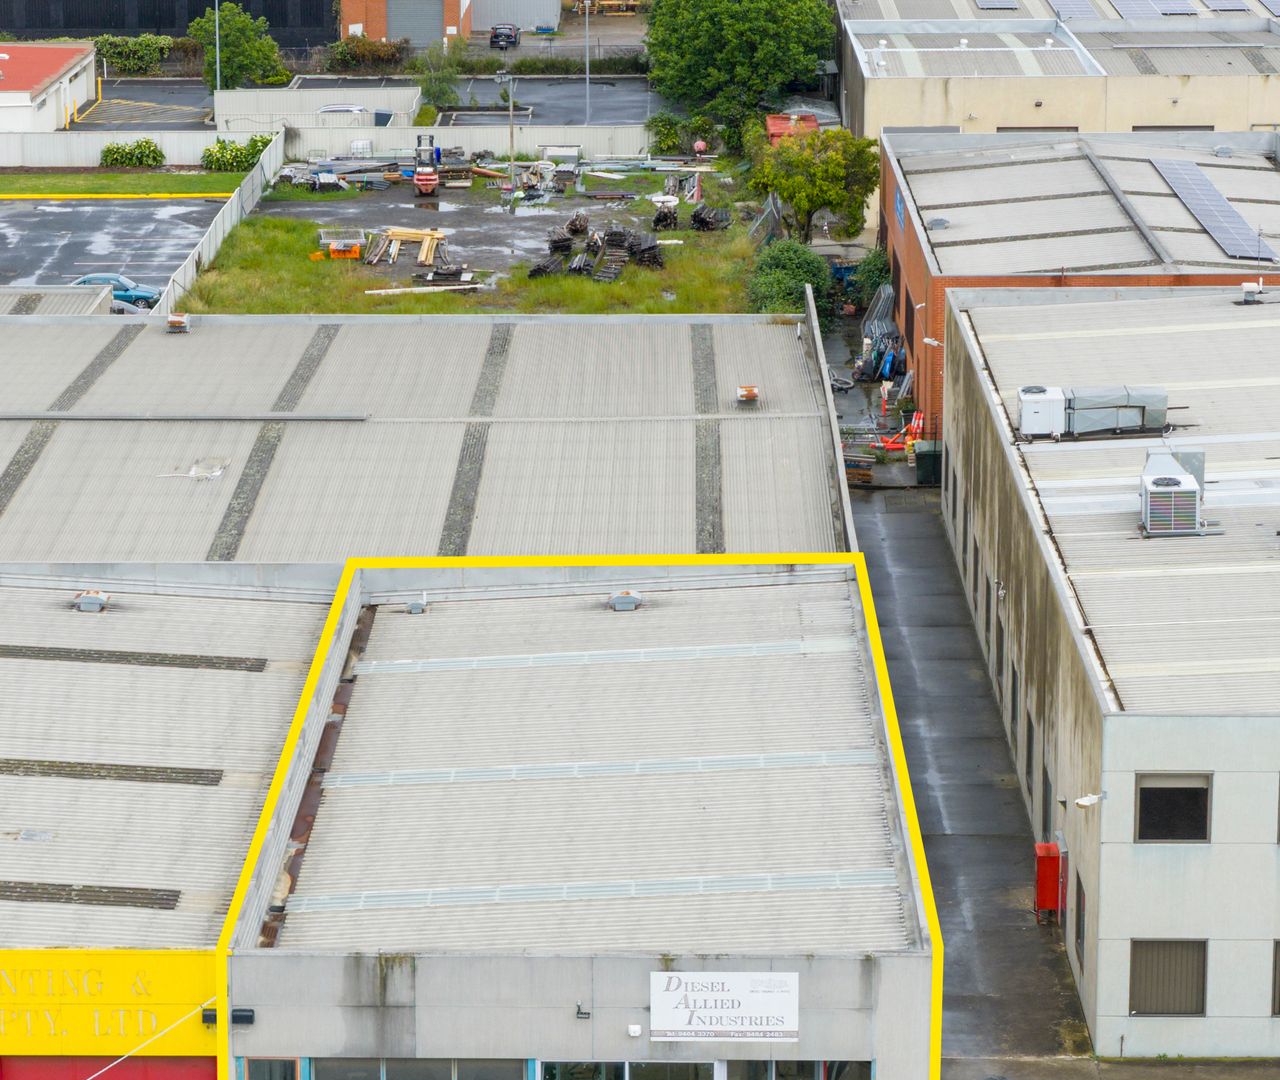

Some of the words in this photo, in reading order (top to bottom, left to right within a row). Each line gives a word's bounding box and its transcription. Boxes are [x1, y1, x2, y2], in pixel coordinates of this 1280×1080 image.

[131, 969, 153, 997] &
[663, 975, 731, 993] DIESEL
[673, 993, 741, 1010] ALLIED
[93, 1008, 157, 1037] LTD
[685, 1009, 785, 1027] INDUSTRIES
